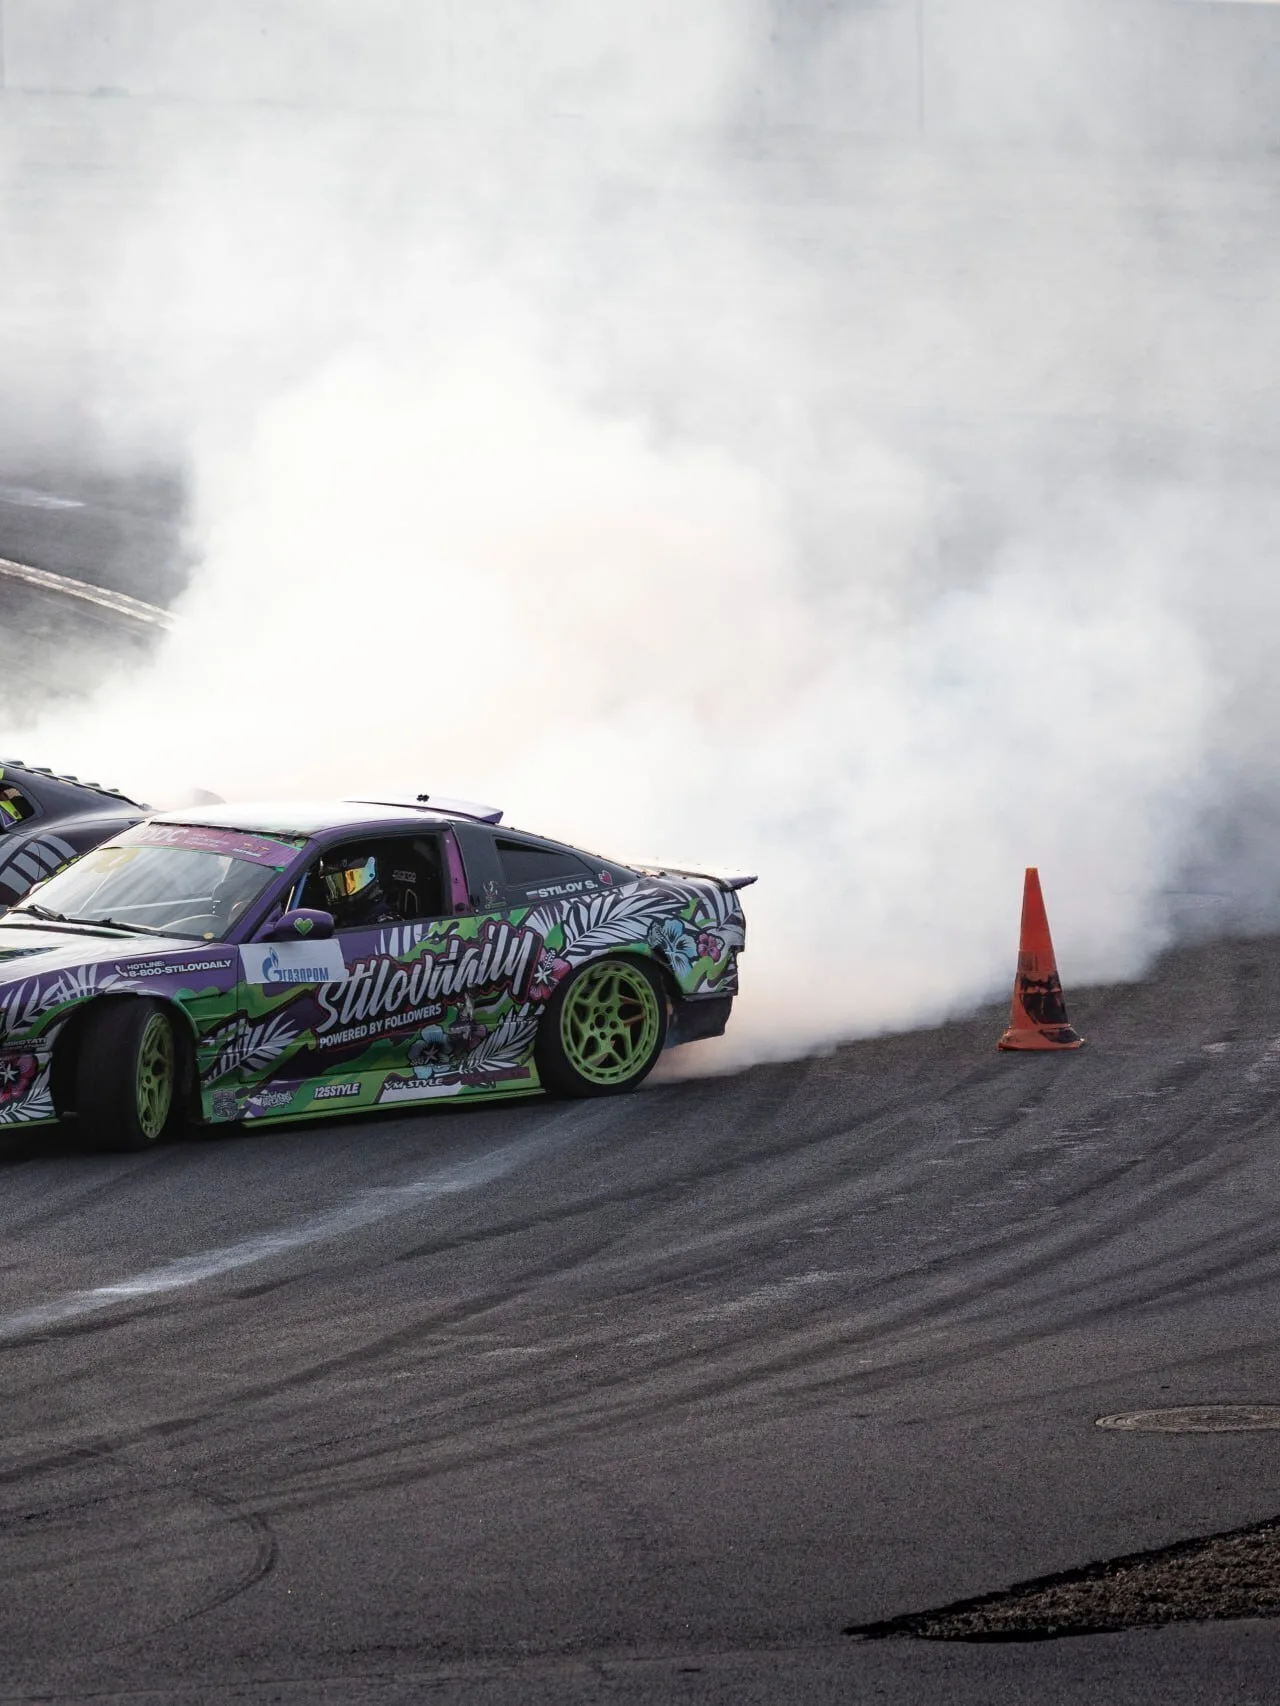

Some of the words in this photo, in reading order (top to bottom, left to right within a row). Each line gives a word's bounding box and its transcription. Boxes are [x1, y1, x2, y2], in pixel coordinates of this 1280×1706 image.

[539, 882, 583, 898] STILOV
[585, 879, 598, 889] S.
[127, 960, 165, 970] HOTLINE:
[128, 959, 233, 978] 8-800-STILOVDAILY
[283, 966, 329, 982] ГАЗПРОМ
[319, 1024, 368, 1049] POWERED
[369, 1020, 384, 1036] BY
[384, 1004, 443, 1031] FOLLOWERS
[313, 1082, 361, 1099] 125STYLE
[407, 1077, 444, 1090] STYLE
